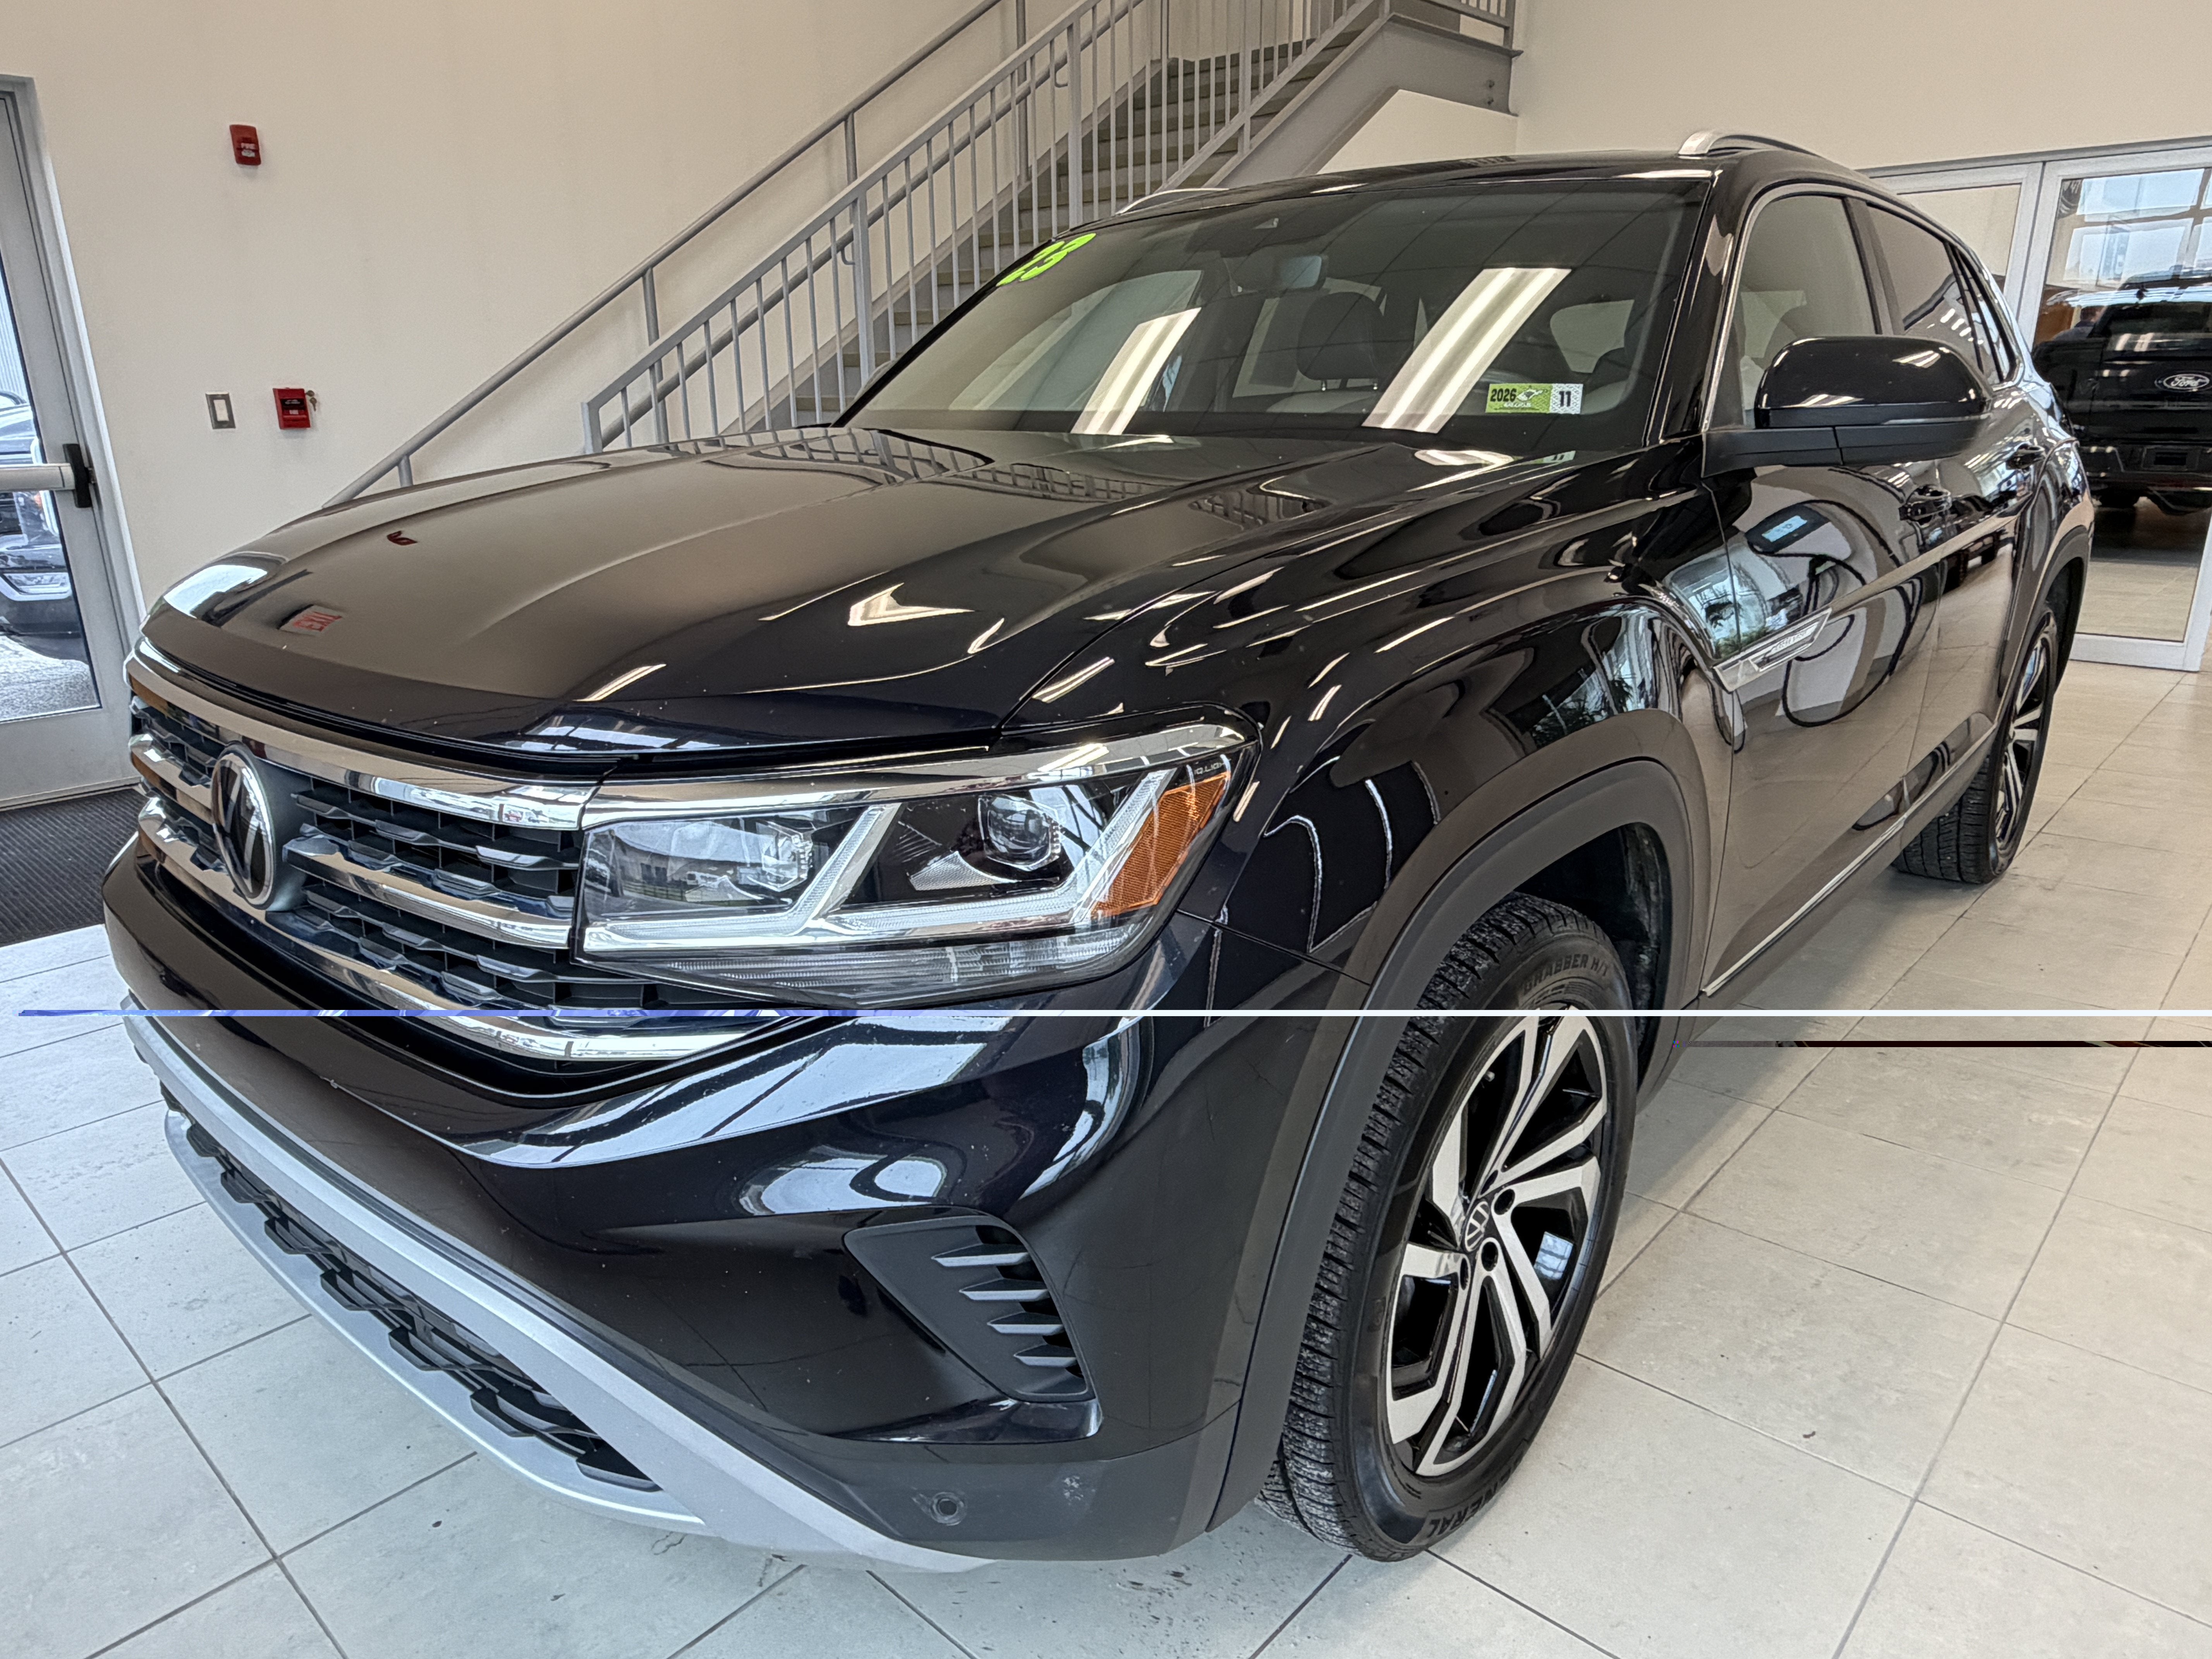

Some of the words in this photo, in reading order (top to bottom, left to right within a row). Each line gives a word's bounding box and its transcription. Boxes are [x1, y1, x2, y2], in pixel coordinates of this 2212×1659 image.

[2170, 376, 2206, 387] Ford
[1490, 388, 1517, 402] 2026
[1558, 390, 1571, 407] 11
[1523, 953, 1589, 996] GRABBER
